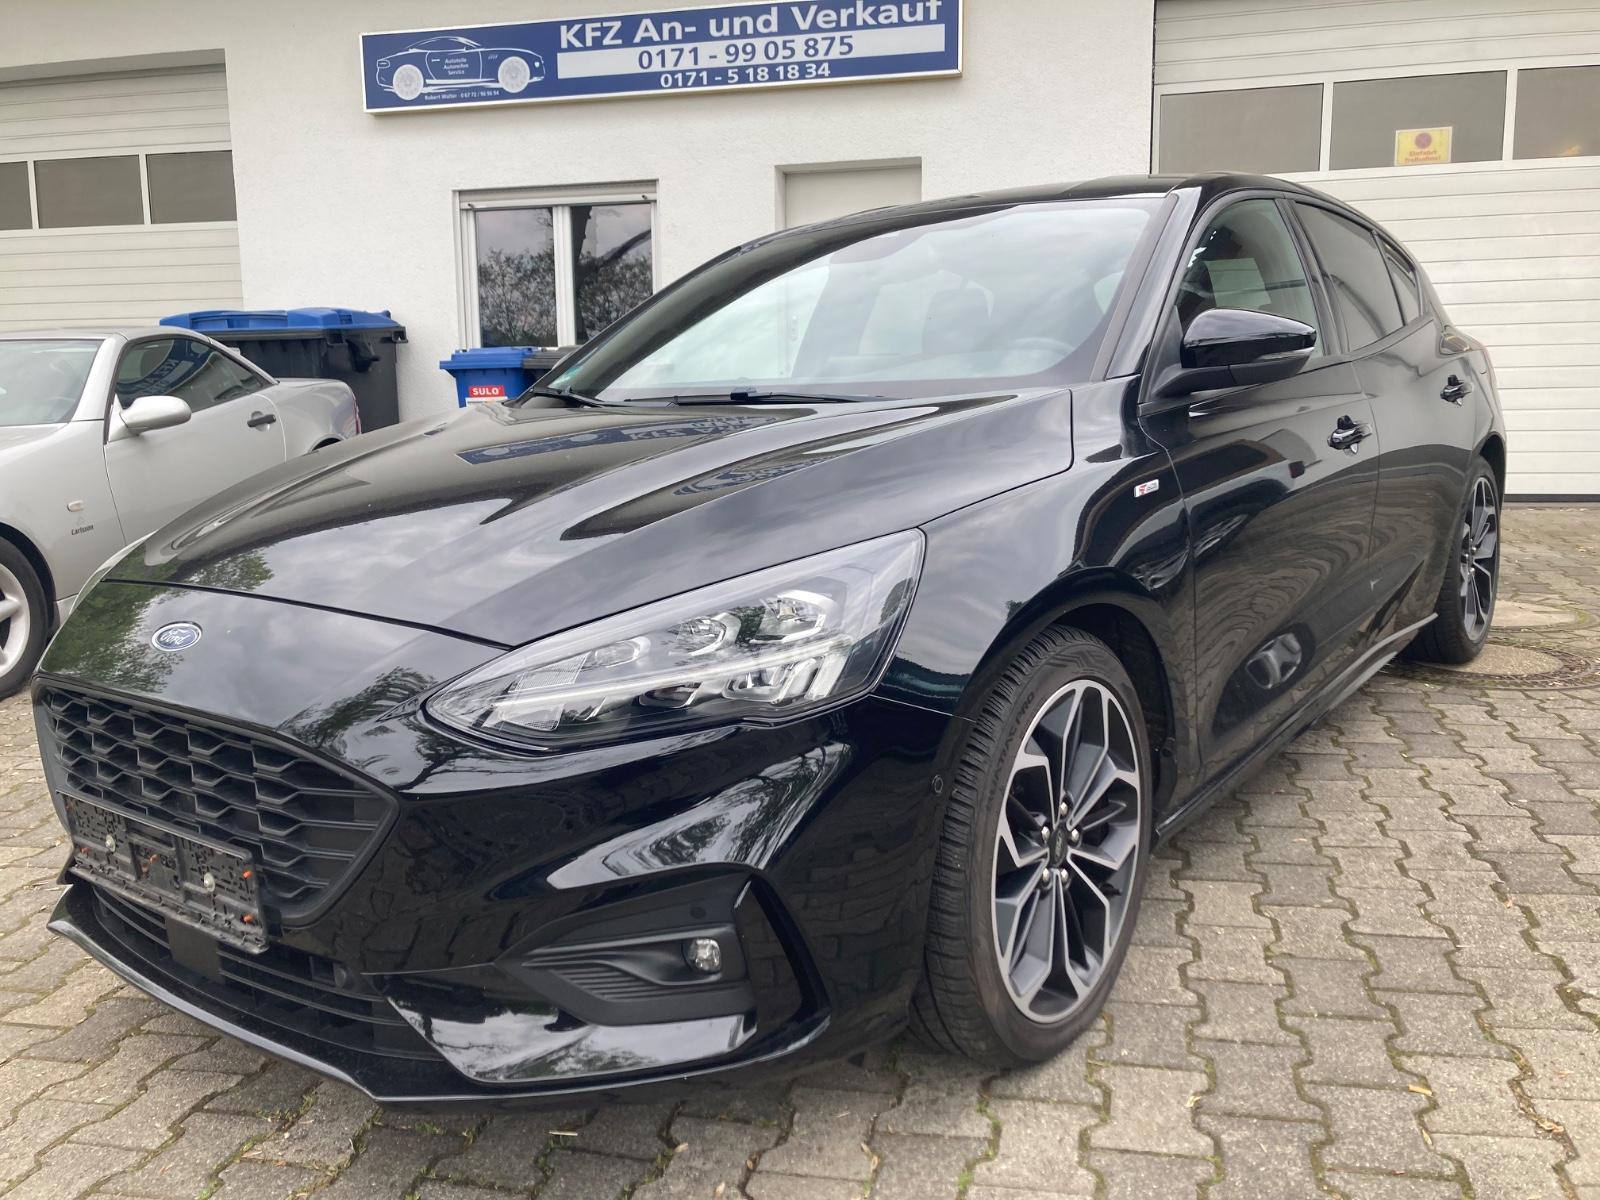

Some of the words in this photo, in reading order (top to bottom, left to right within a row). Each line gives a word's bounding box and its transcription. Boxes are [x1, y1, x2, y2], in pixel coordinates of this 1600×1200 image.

[560, 21, 623, 49] KFZ
[633, 18, 697, 43] An-
[709, 6, 778, 37] und
[791, 0, 942, 31] Verkauf
[638, 46, 699, 70] 0171
[725, 42, 756, 64] 99
[764, 40, 796, 61] 05
[804, 35, 854, 58] 875
[660, 71, 708, 88] 0171
[727, 69, 739, 84] 5
[745, 67, 769, 82] 18
[775, 64, 800, 80] 18
[805, 62, 831, 78] 34
[472, 387, 500, 396] SULO
[160, 628, 192, 645] Ford
